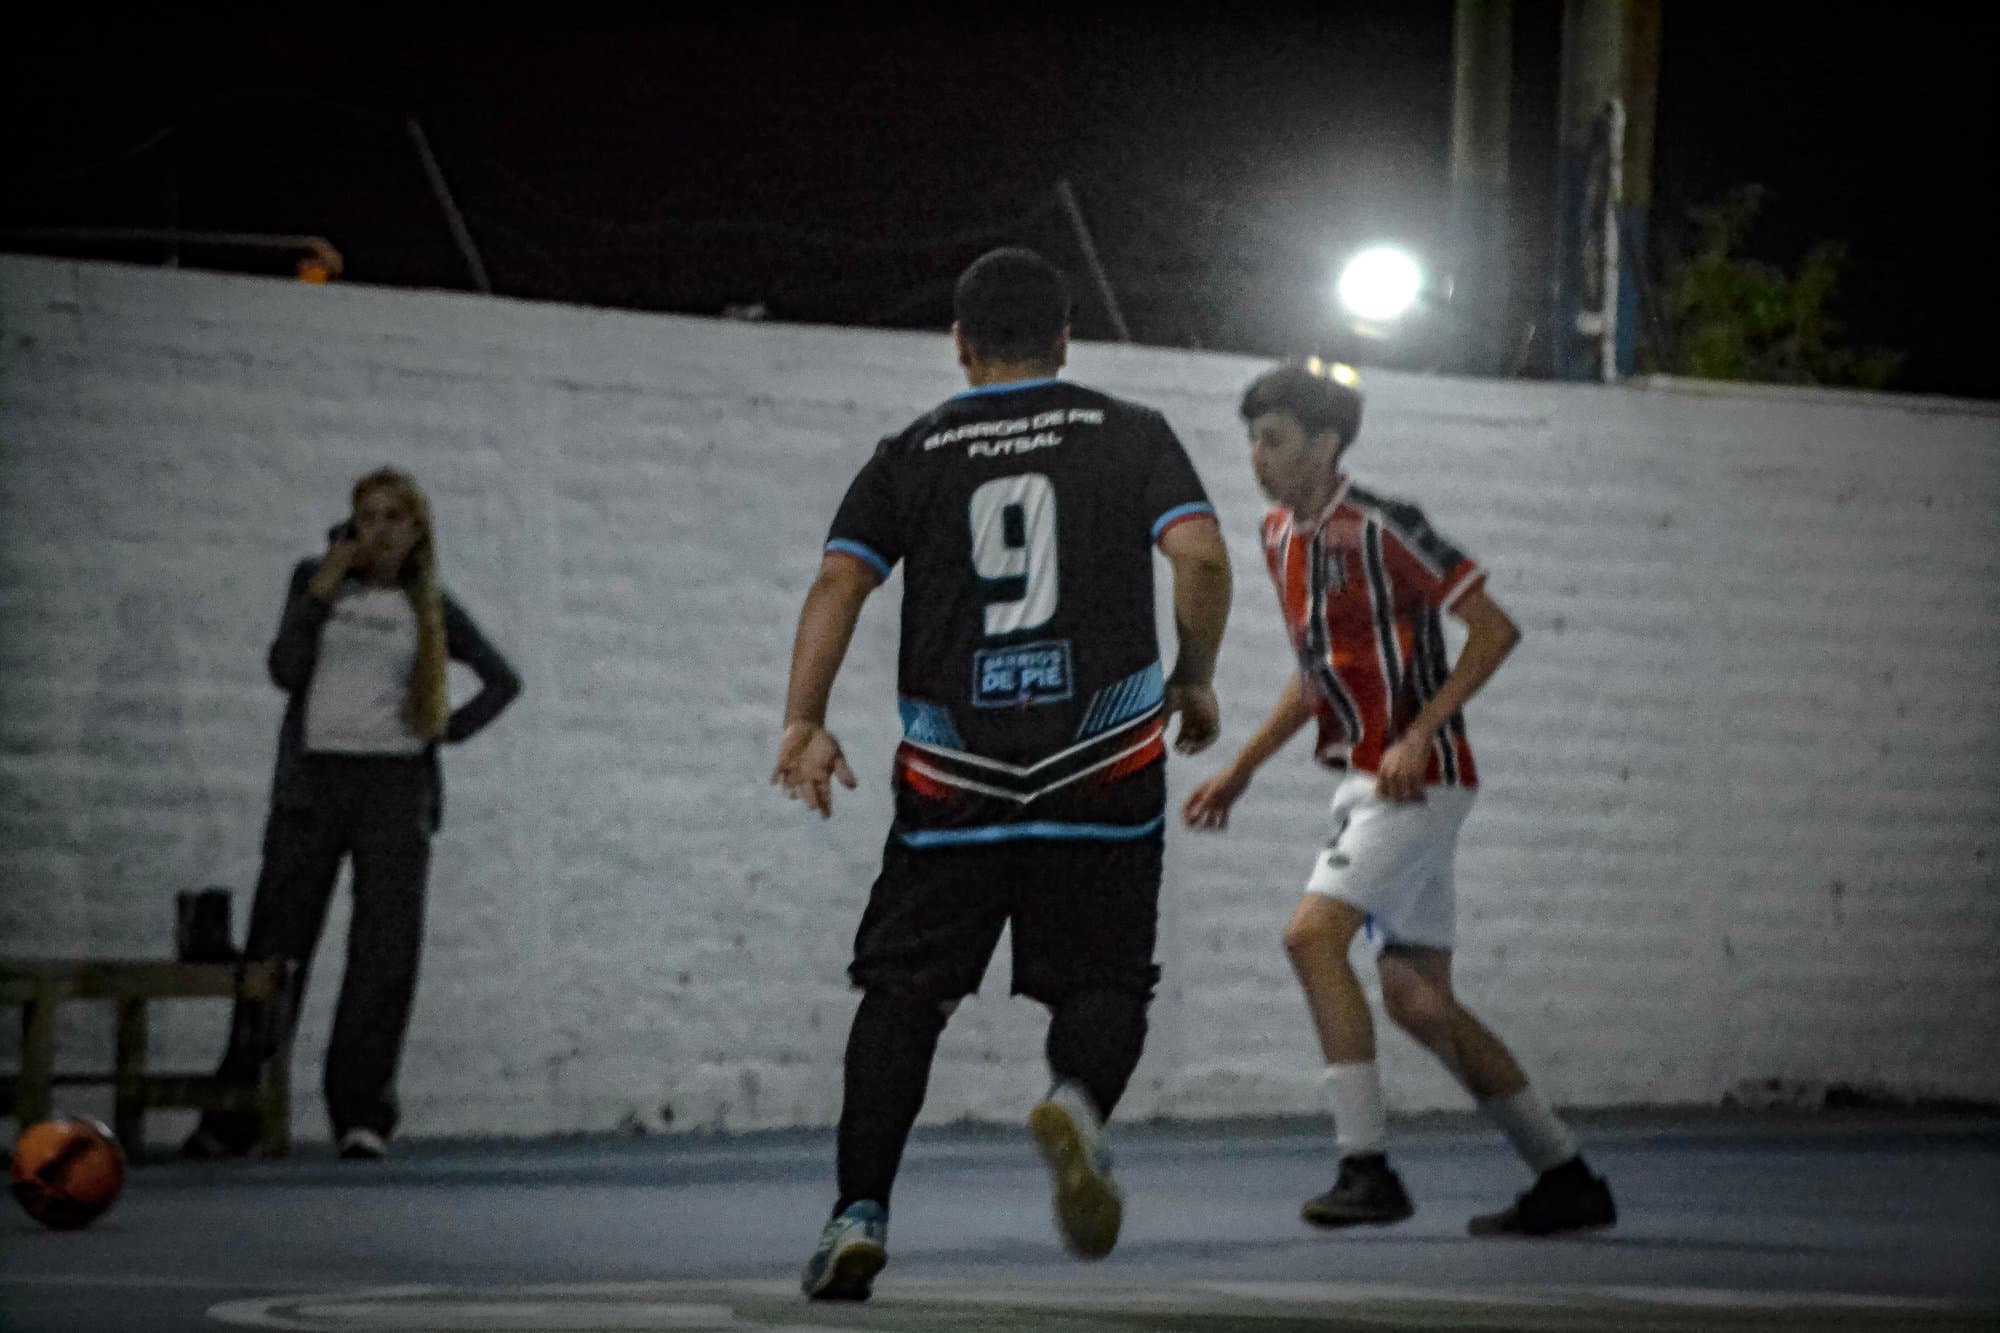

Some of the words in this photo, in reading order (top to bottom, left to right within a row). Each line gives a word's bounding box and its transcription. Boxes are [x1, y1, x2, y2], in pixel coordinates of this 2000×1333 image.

[1033, 409, 1065, 429] DE
[1068, 408, 1103, 424] PIE
[967, 432, 1063, 457] FUTSAL
[970, 472, 1058, 636] 9
